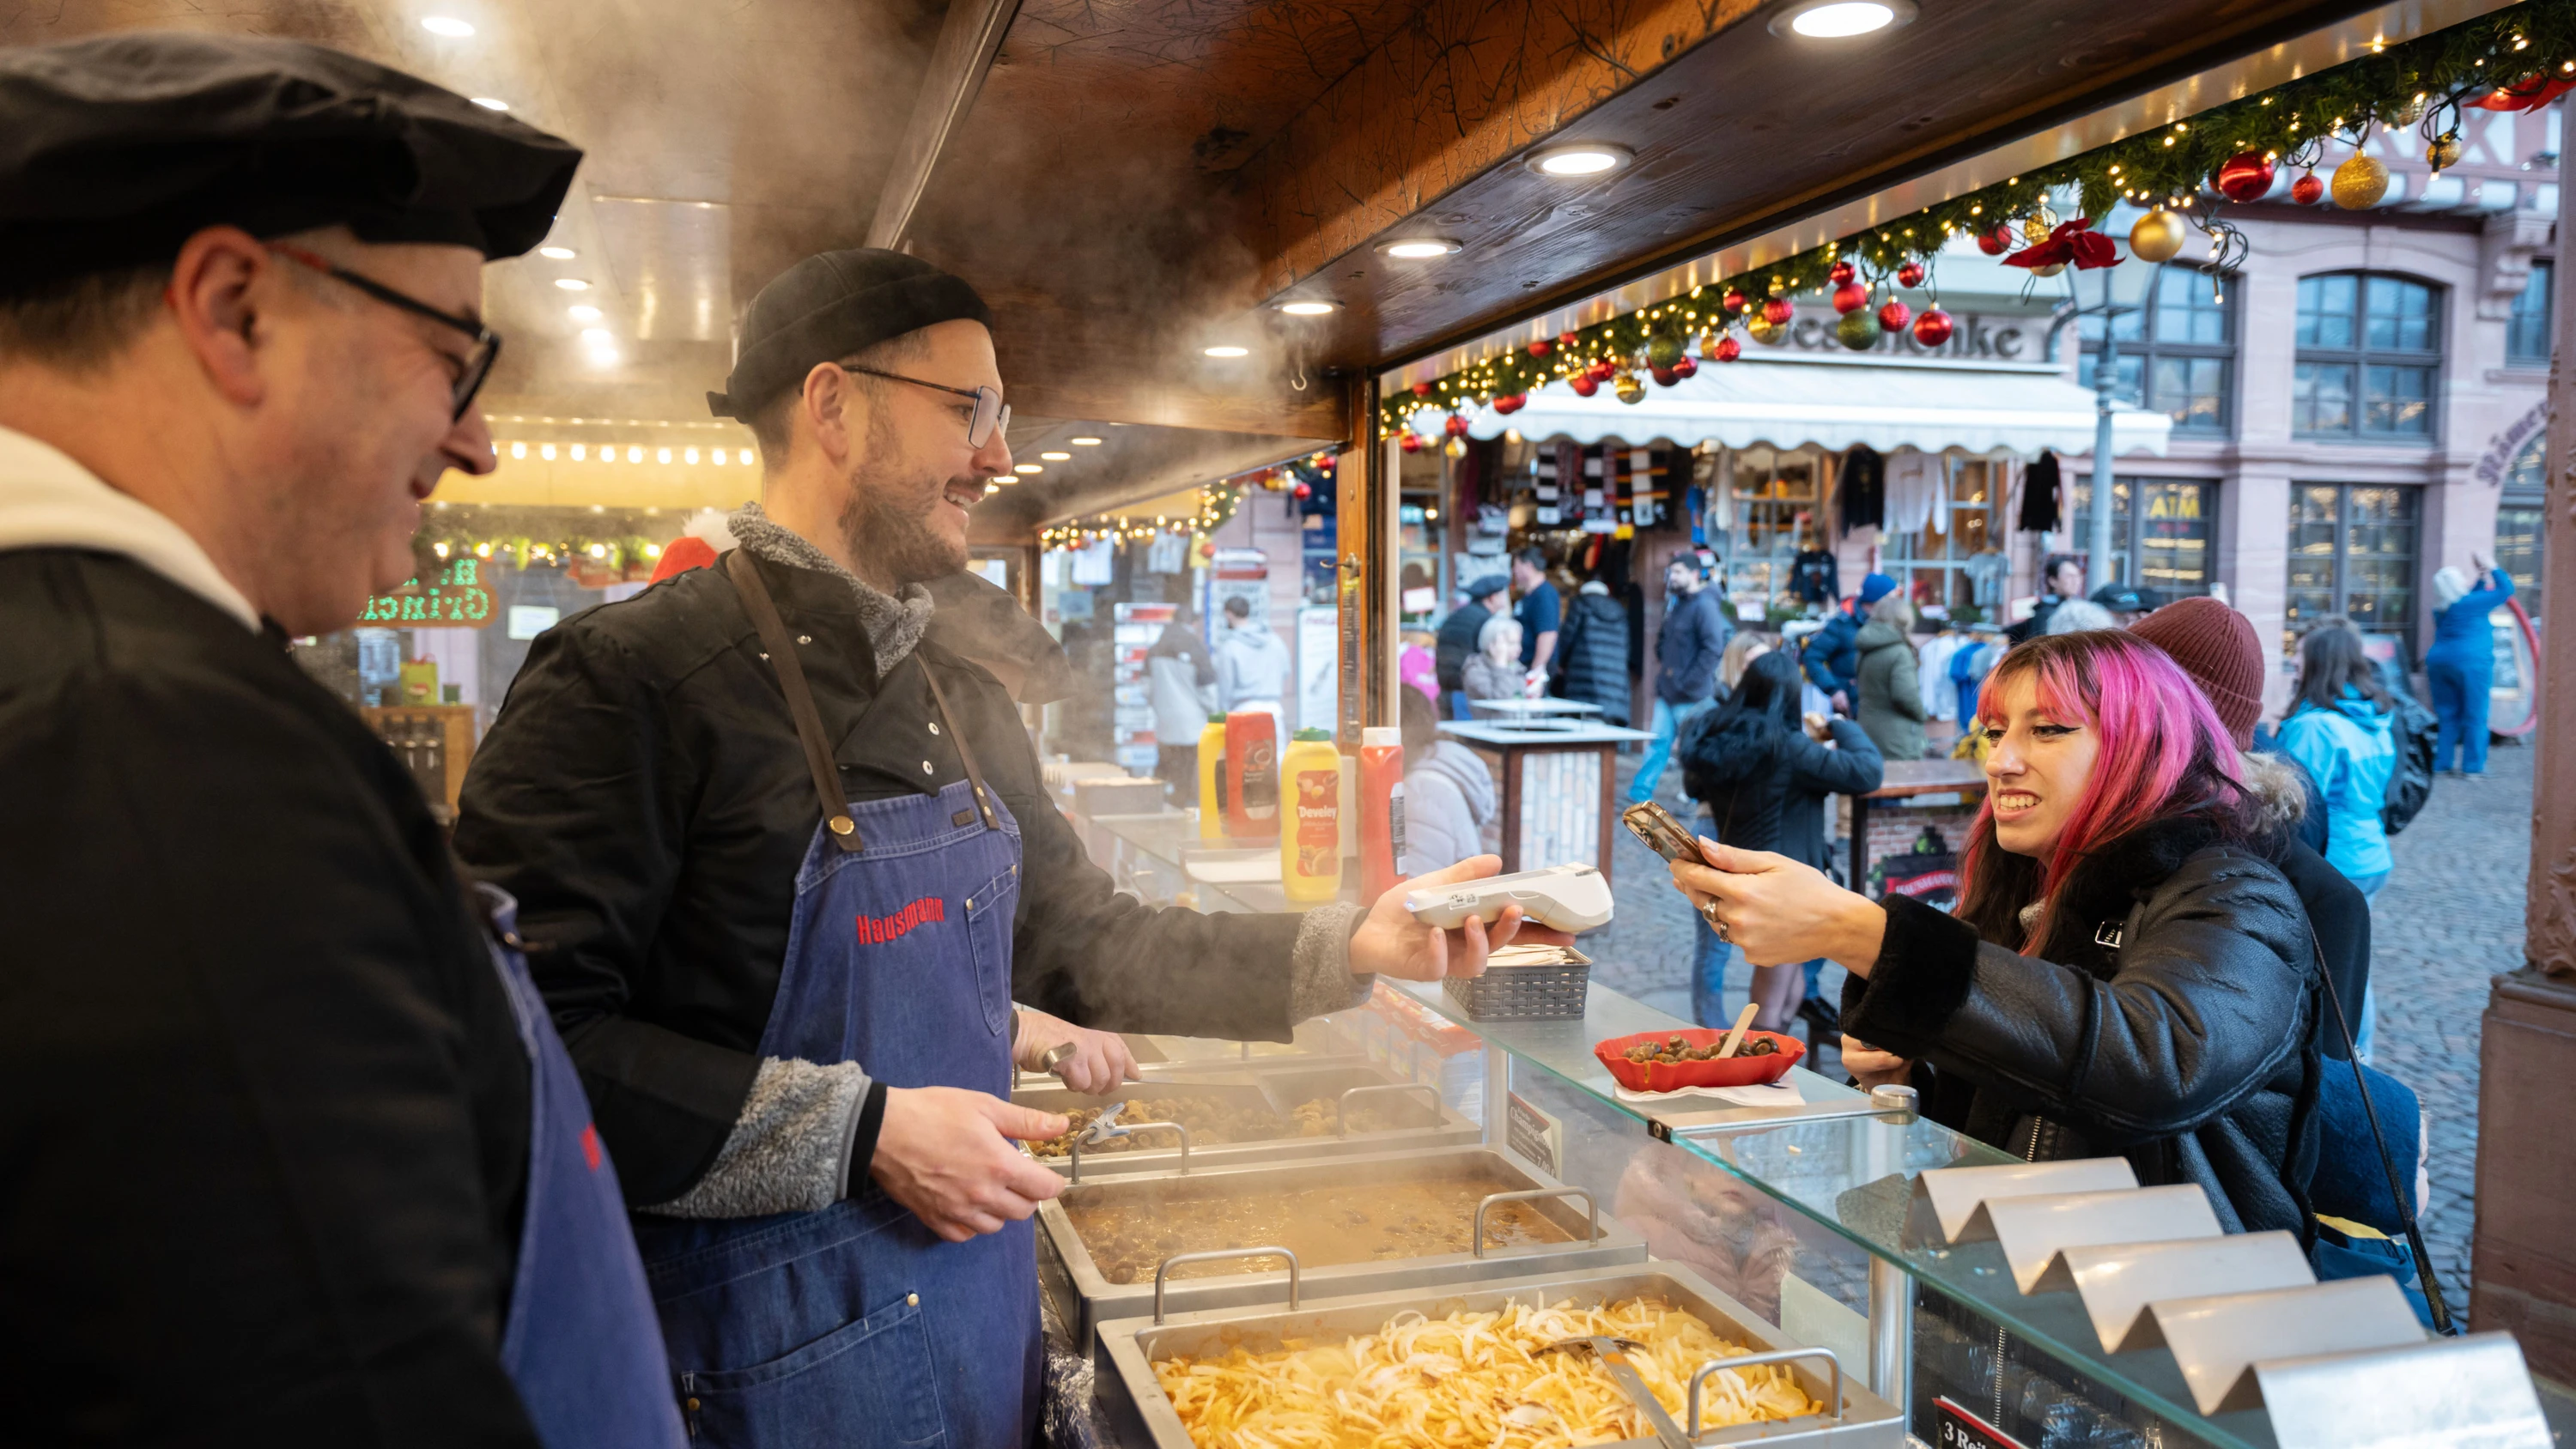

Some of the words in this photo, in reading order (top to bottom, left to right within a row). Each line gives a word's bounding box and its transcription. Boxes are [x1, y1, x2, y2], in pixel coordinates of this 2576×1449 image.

[2149, 495, 2201, 519] ATM
[1297, 804, 1339, 819] Develey
[856, 897, 945, 945] Hausmann
[1944, 1421, 1955, 1442] 3
